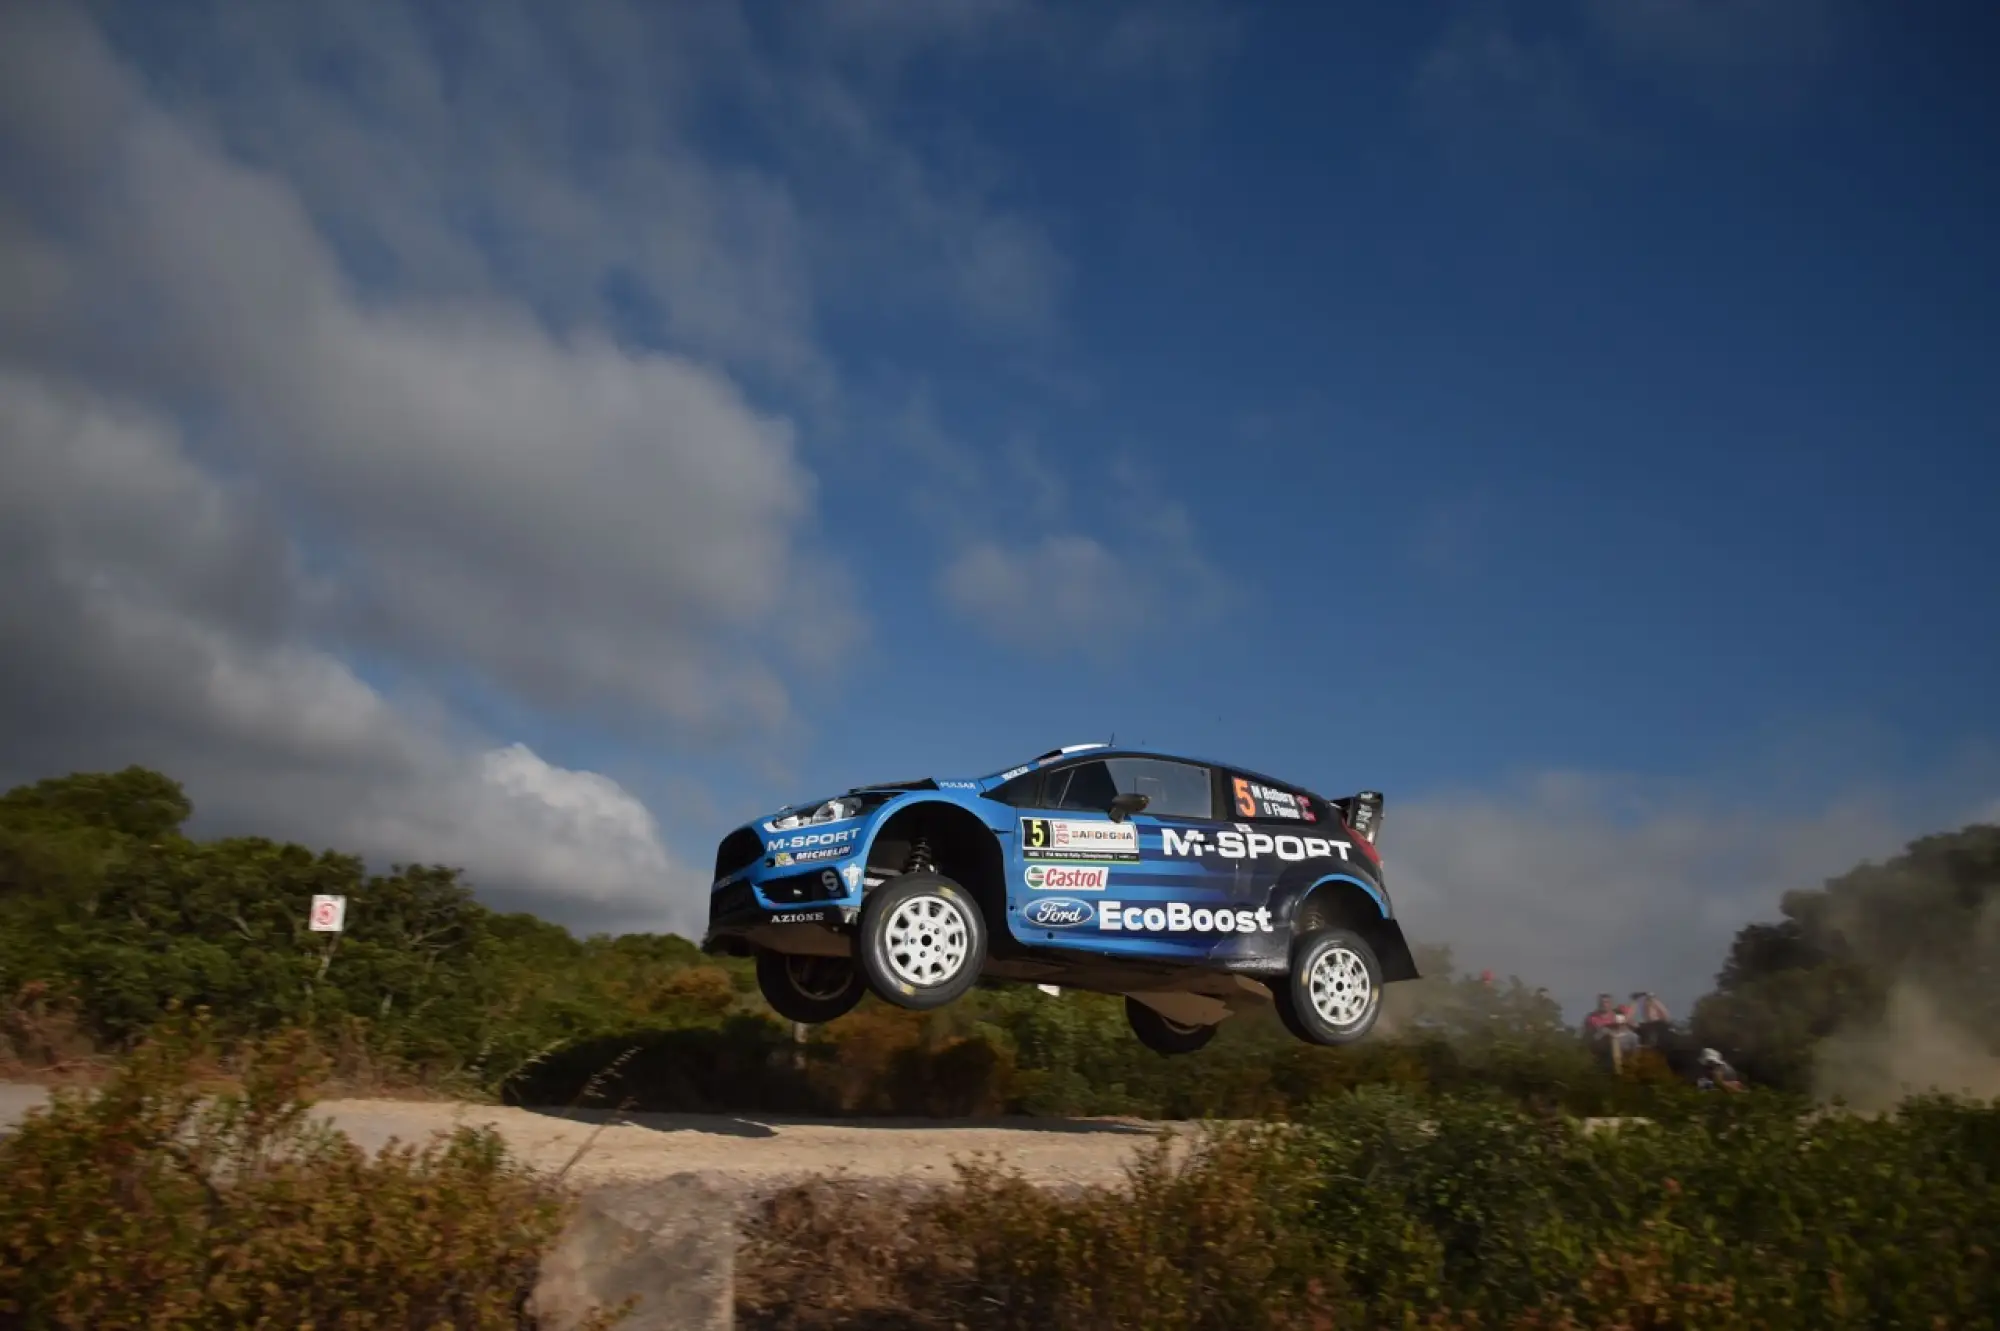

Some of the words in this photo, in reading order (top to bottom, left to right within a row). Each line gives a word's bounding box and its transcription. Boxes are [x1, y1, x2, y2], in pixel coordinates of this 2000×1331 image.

[1233, 777, 1256, 817] 5
[767, 828, 861, 852] M-SPORT
[1032, 820, 1045, 848] 5
[1071, 831, 1133, 840] SARDEGNA
[1160, 827, 1352, 862] M-SPORT
[796, 846, 851, 860] MICHELIN
[1046, 867, 1103, 888] Castrol
[771, 912, 824, 923] AZIONE
[1036, 901, 1082, 923] Ford
[1098, 900, 1274, 932] EcoBoost
